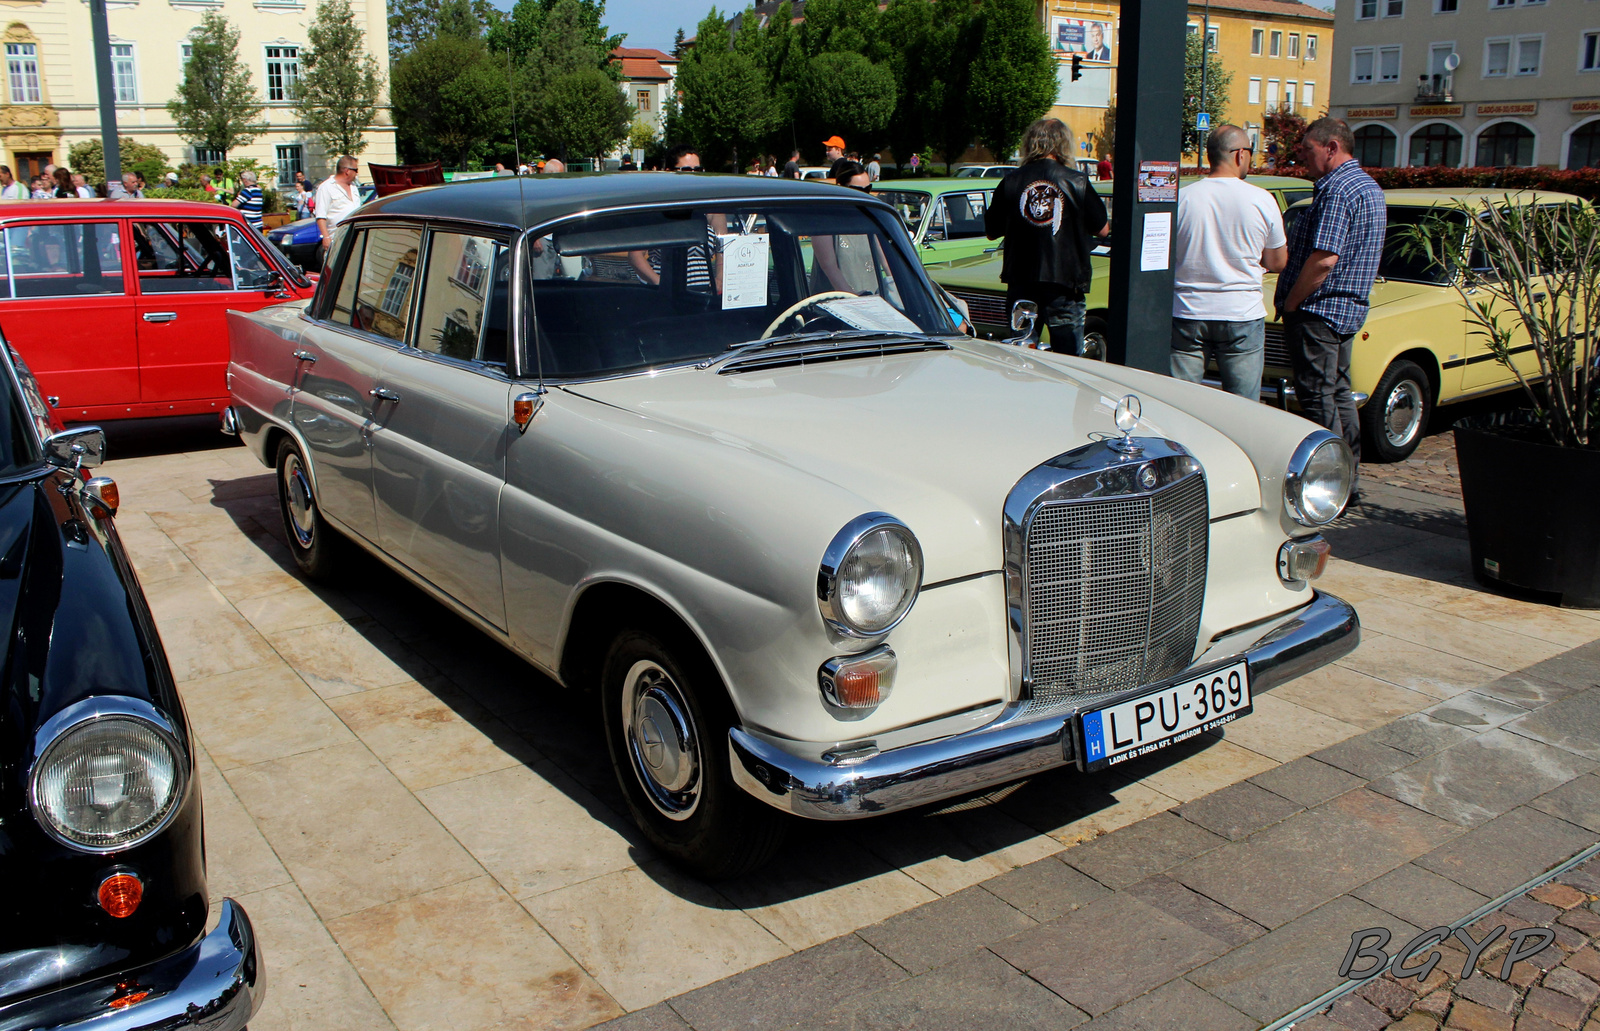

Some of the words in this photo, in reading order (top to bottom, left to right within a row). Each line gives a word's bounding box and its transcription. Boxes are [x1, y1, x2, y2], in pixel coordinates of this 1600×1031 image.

[740, 247, 751, 258] 64
[1110, 670, 1242, 750] LPU-369
[1091, 740, 1101, 756] H
[1108, 753, 1129, 766] LADIK
[1128, 749, 1138, 759] ÉS
[1137, 743, 1159, 756] TÁRSA
[1158, 738, 1172, 749] KFT.
[1173, 726, 1202, 744] KOMÁROM
